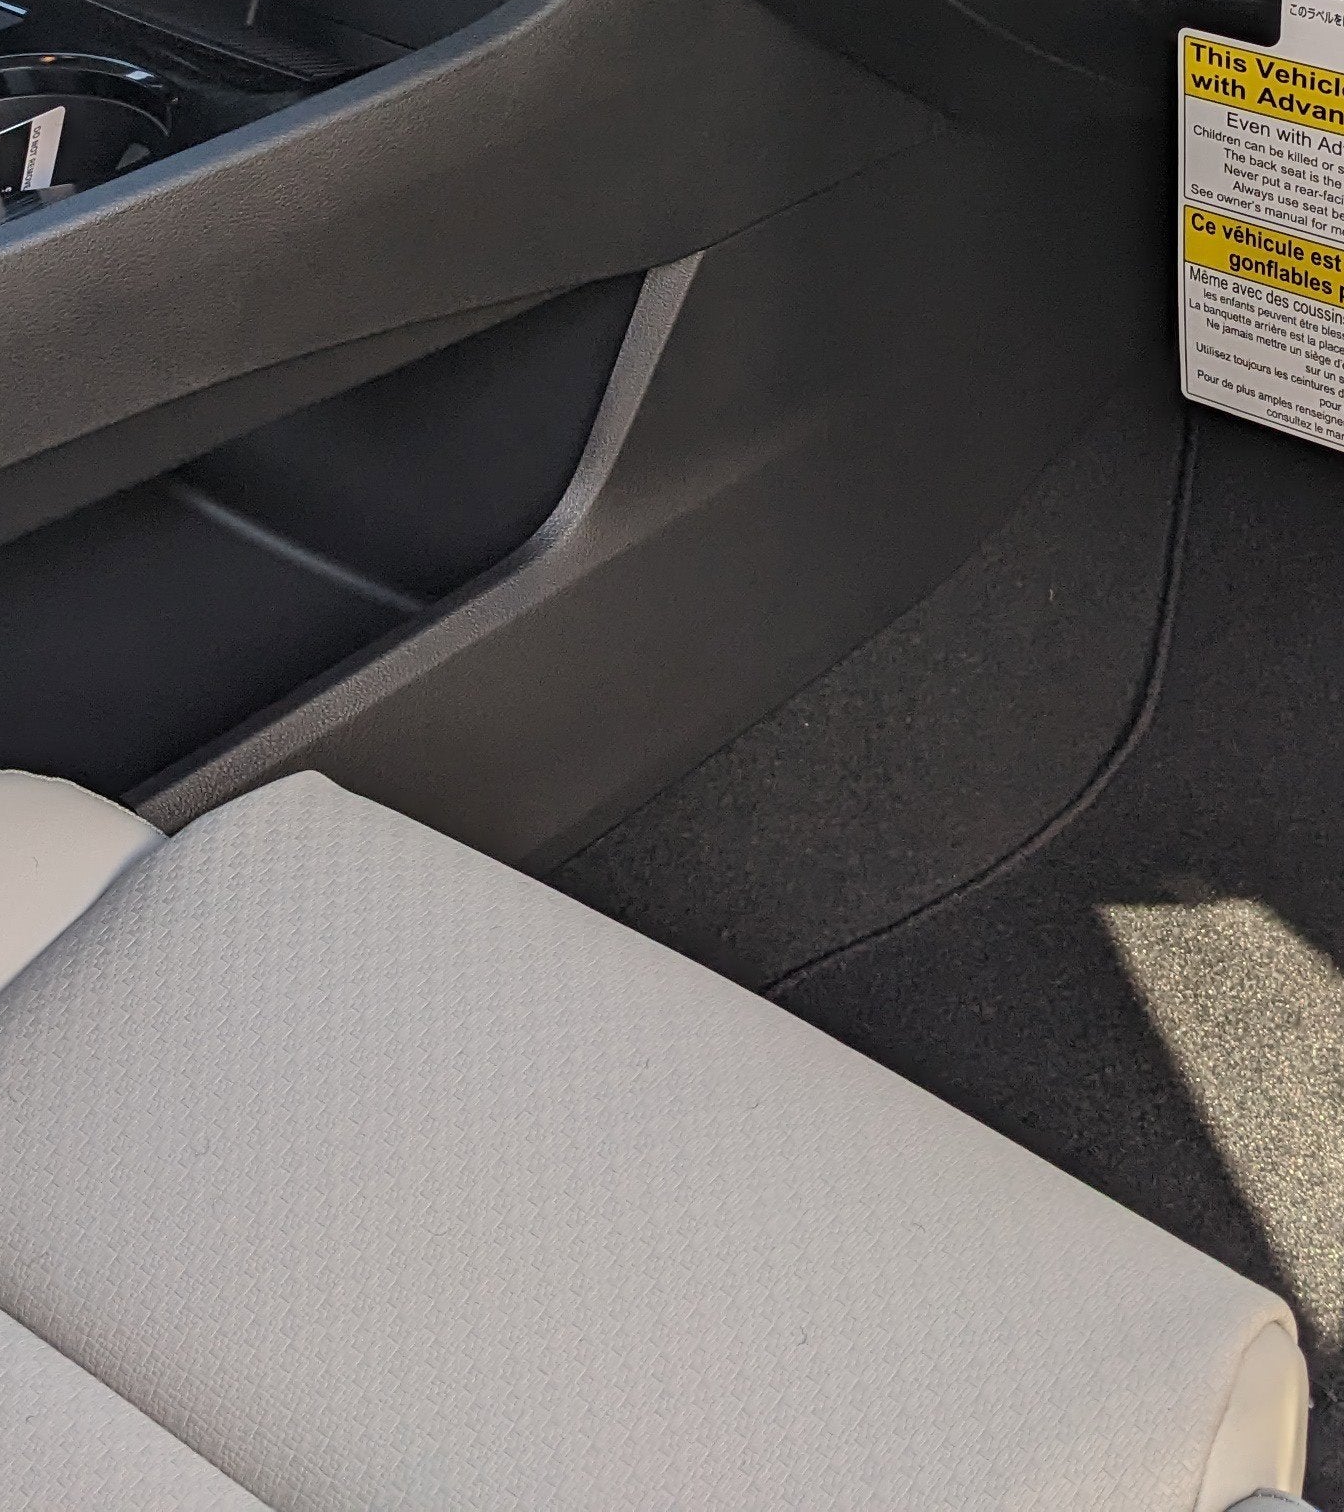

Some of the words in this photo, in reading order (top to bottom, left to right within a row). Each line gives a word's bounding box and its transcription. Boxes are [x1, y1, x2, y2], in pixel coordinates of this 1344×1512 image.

[1189, 41, 1248, 73] This
[1190, 73, 1246, 100] with
[1193, 124, 1241, 148] Children
[1244, 140, 1266, 154] can
[1269, 144, 1284, 159] be
[1287, 149, 1318, 168] killed
[1321, 161, 1335, 172] or
[1226, 111, 1271, 138] Even
[1276, 128, 1312, 149] with
[1223, 147, 1246, 164] The
[1249, 154, 1278, 173] back
[1280, 165, 1307, 181] seat
[1309, 170, 1320, 184] is
[1322, 174, 1342, 190] the
[1224, 162, 1260, 182] Never
[1261, 175, 1281, 189] put
[1283, 181, 1292, 191] a
[1190, 183, 1214, 199] See
[1216, 193, 1262, 213] owner's
[1264, 206, 1308, 227] manual
[1311, 217, 1328, 231] for
[1232, 180, 1275, 202] Always
[1277, 195, 1299, 209] use
[1302, 202, 1328, 217] seat
[1191, 212, 1217, 236] Ce
[1221, 224, 1305, 261] véhicule
[1310, 251, 1342, 273] est
[1229, 253, 1333, 295] gonflables
[1231, 281, 1263, 301] avec
[1265, 289, 1290, 309] des
